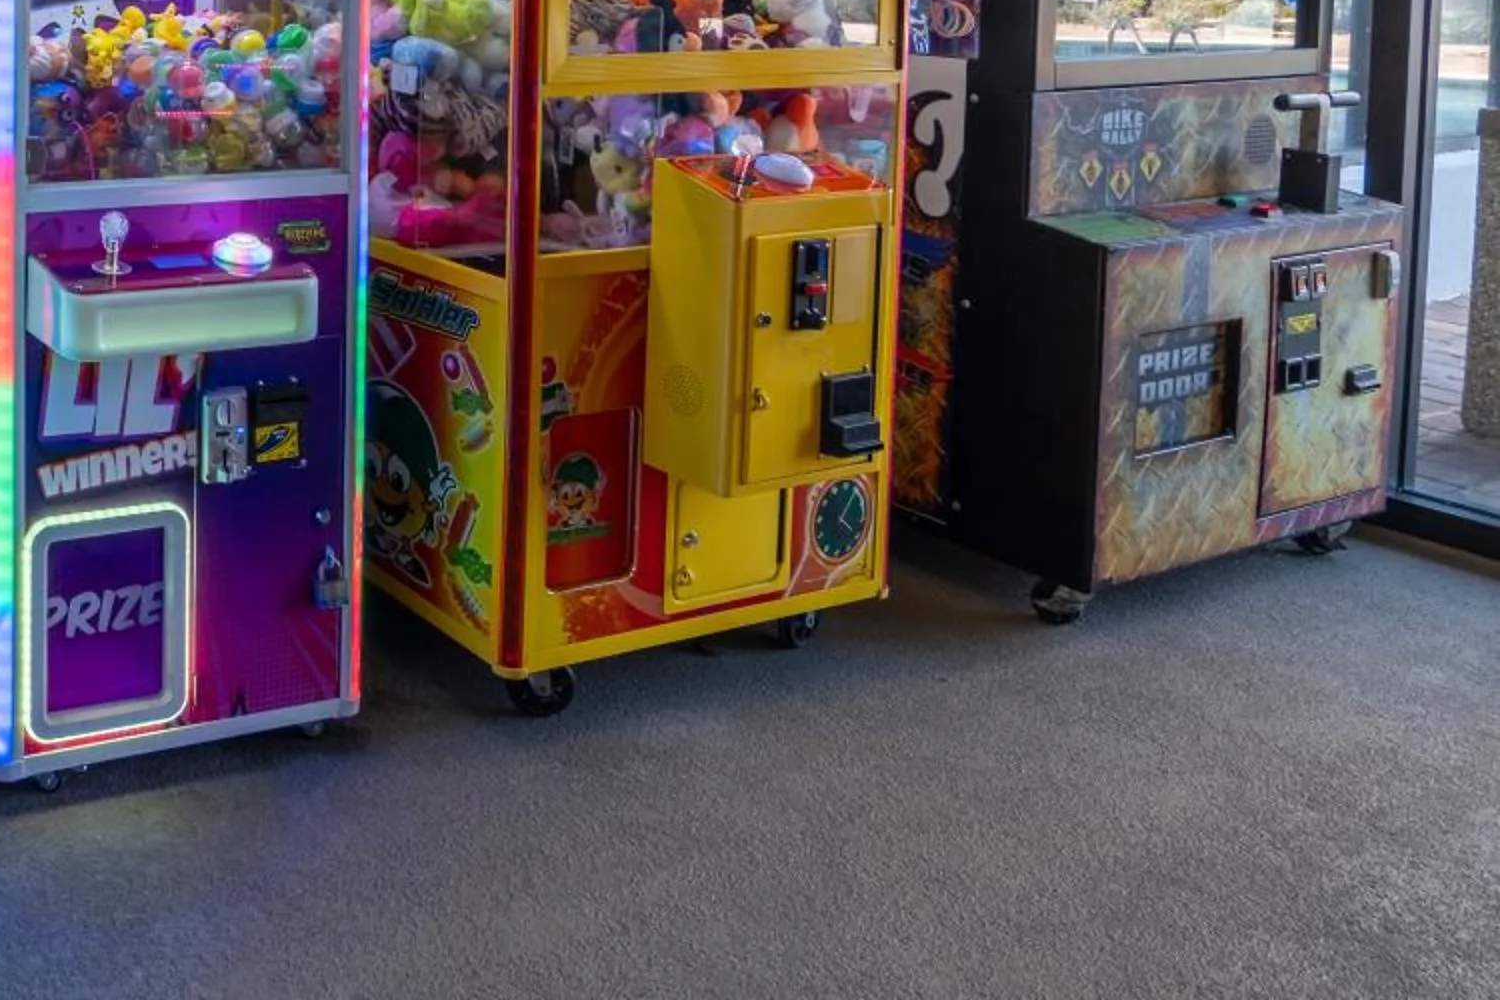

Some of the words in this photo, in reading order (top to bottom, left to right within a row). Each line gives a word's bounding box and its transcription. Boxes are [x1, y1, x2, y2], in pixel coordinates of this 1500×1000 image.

[1102, 109, 1148, 129] BIKE
[1101, 127, 1143, 145] RALLY
[1138, 343, 1216, 377] PRIZE
[1140, 371, 1210, 402] DOOR
[47, 581, 164, 638] PRIZE
